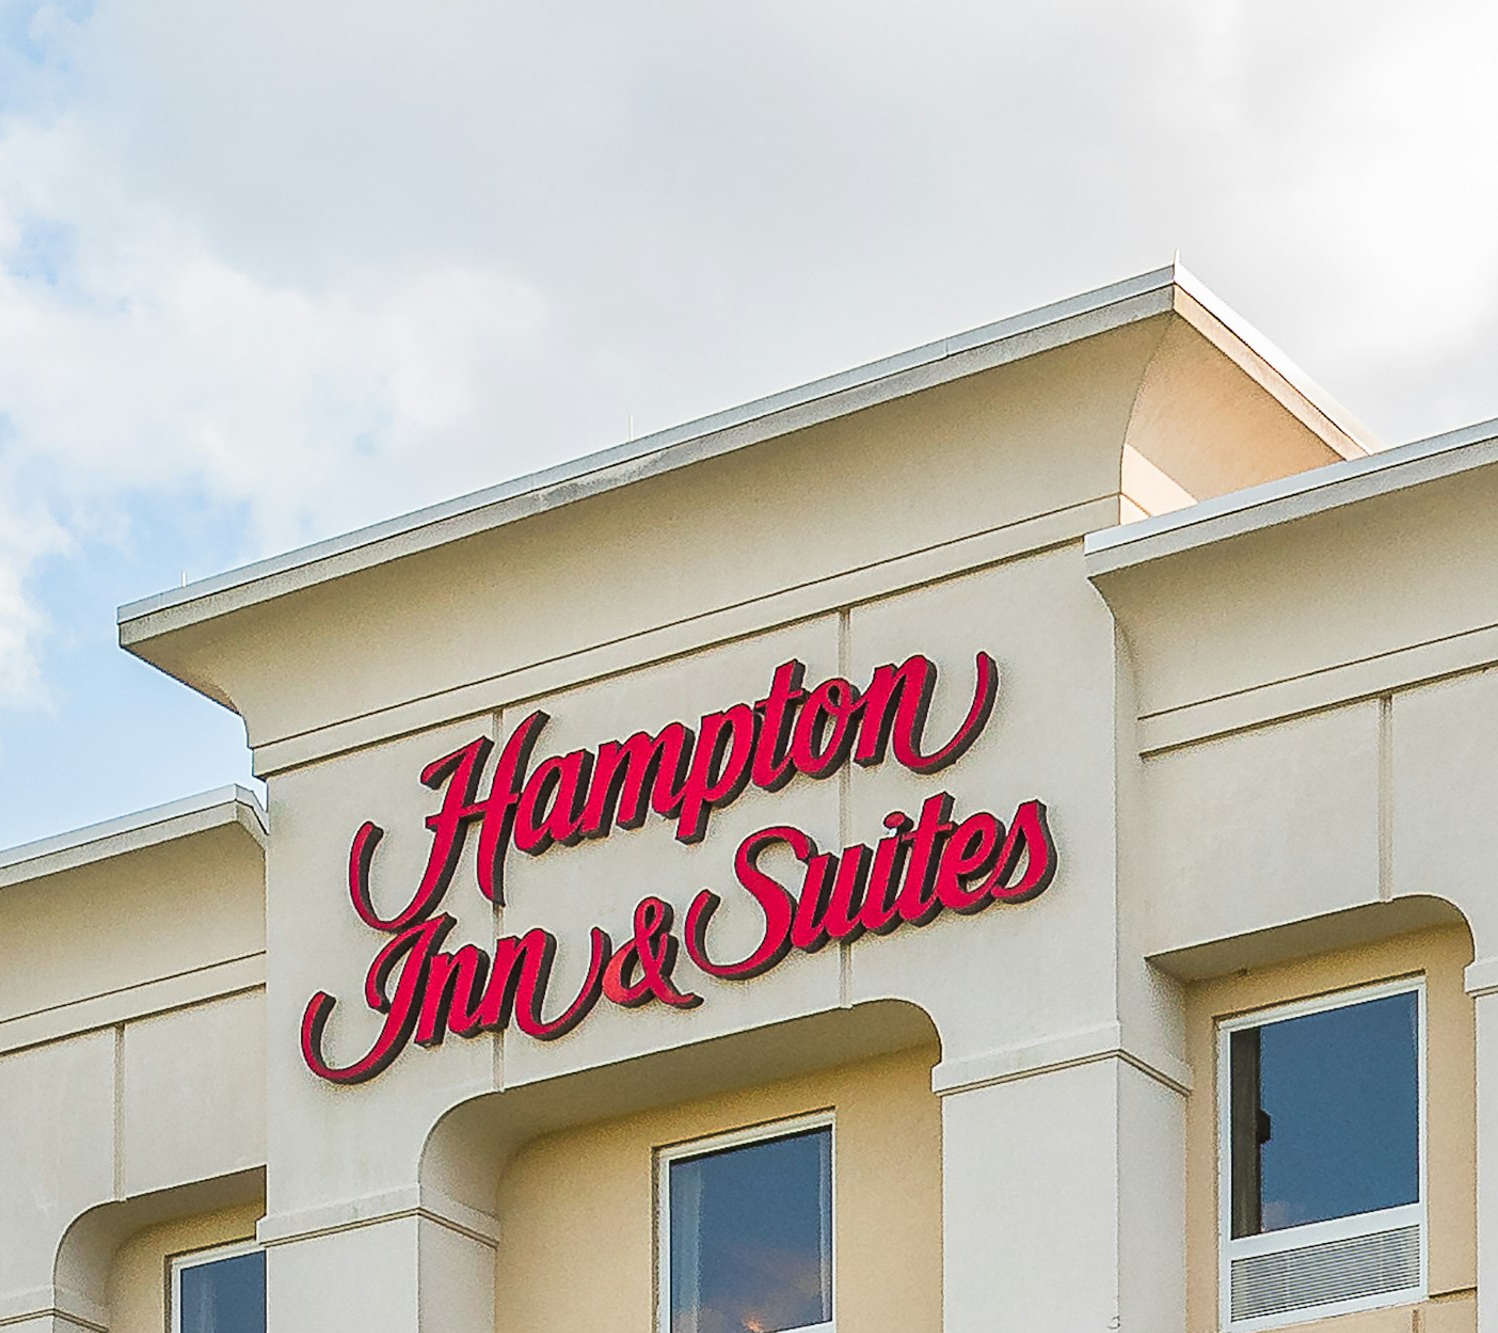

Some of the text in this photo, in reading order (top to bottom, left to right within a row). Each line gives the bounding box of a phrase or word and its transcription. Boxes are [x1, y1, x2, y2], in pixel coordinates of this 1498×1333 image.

[349, 651, 998, 931] Hampton
[301, 792, 1057, 1084] Inn & Suites
